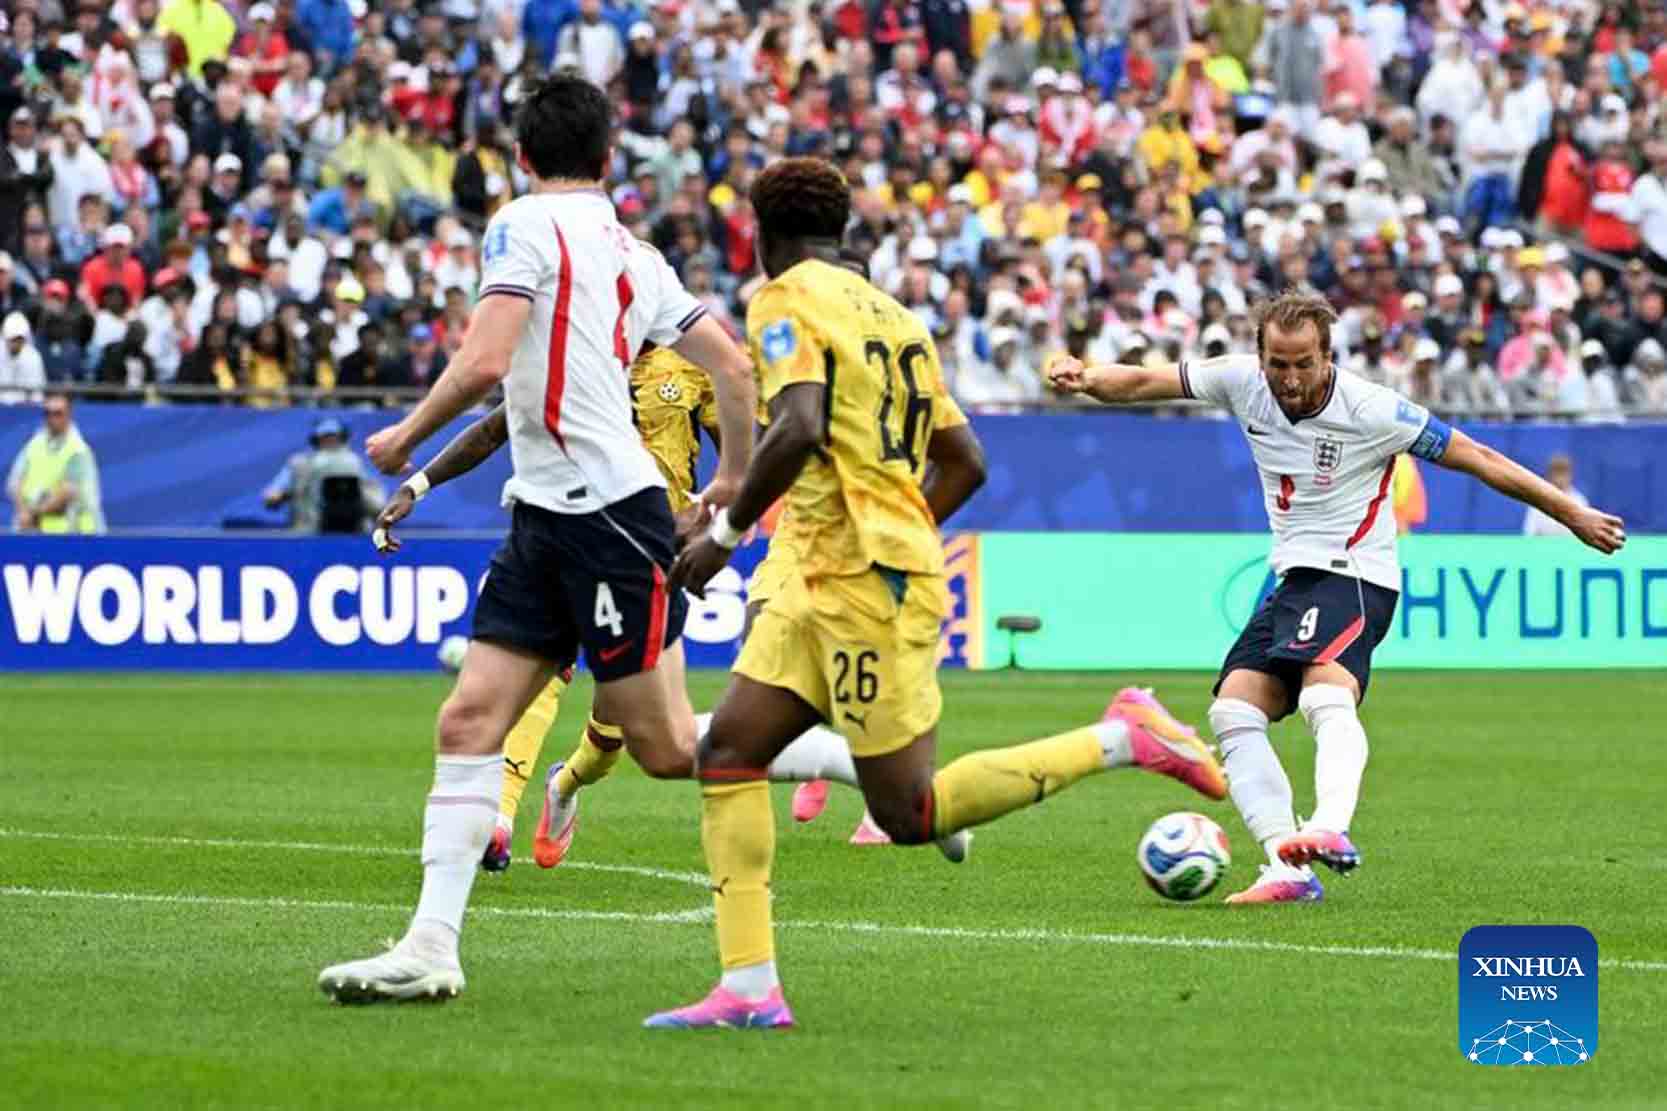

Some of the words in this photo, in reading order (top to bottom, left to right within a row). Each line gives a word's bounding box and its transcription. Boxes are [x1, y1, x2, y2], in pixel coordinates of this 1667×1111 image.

[3, 563, 299, 646] WORLD
[309, 564, 468, 646] CUP
[594, 581, 624, 637] 4
[1297, 606, 1320, 642] 9
[832, 651, 879, 704] 26
